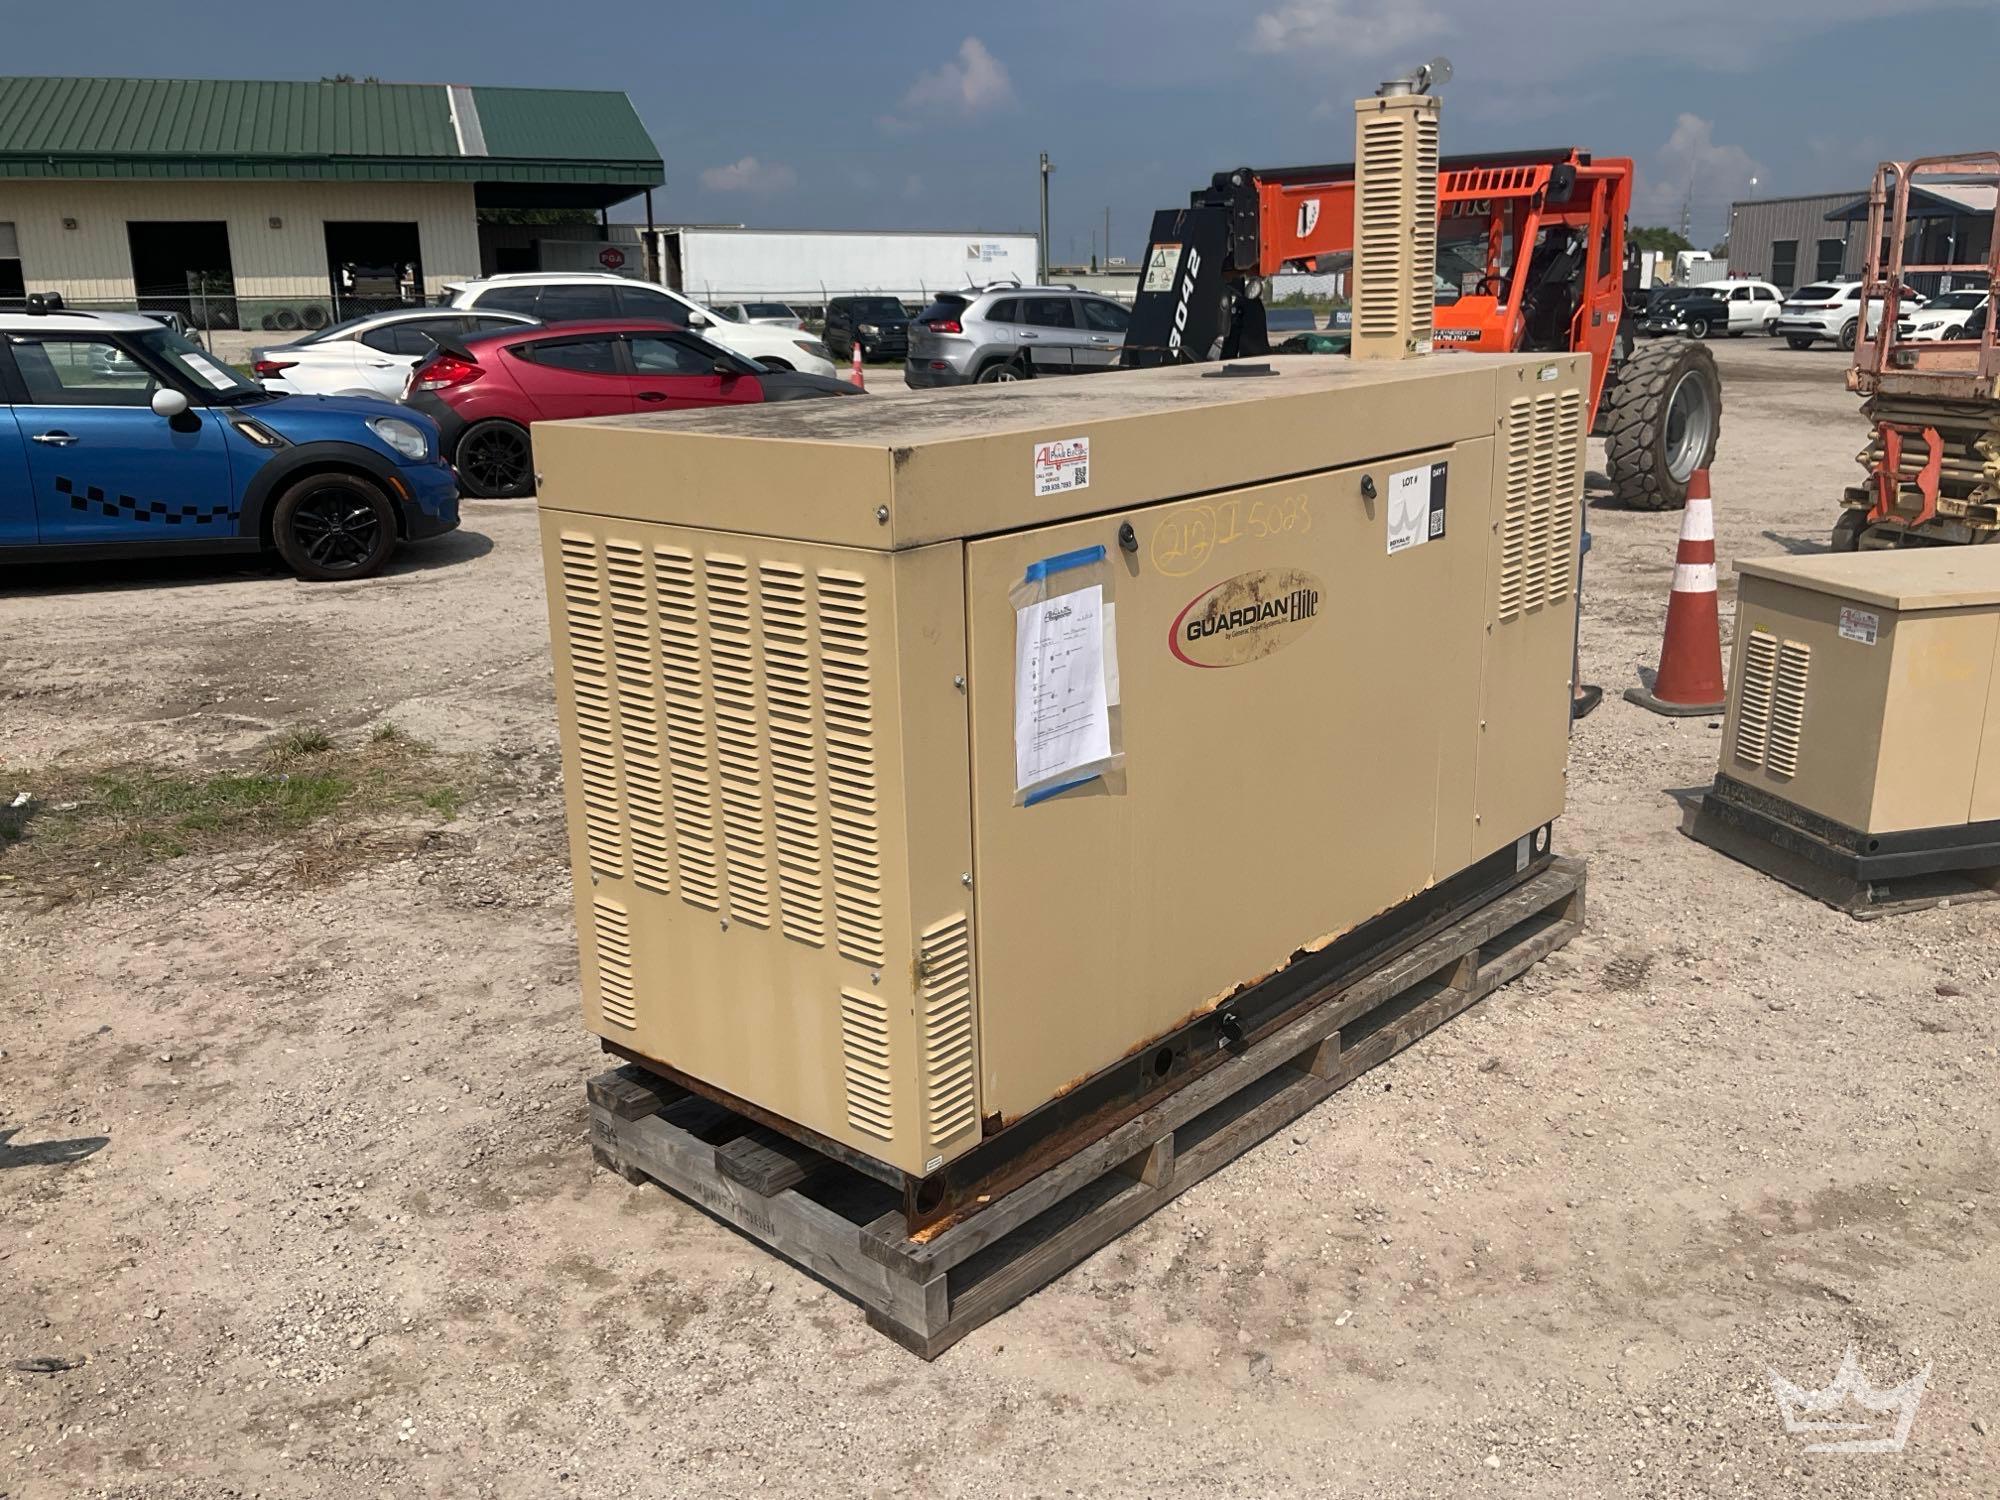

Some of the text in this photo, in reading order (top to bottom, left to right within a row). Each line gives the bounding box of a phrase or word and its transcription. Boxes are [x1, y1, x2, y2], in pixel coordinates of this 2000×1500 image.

[1402, 476, 1413, 487] LOT
[1186, 588, 1319, 642] GUARDIAN Elite
